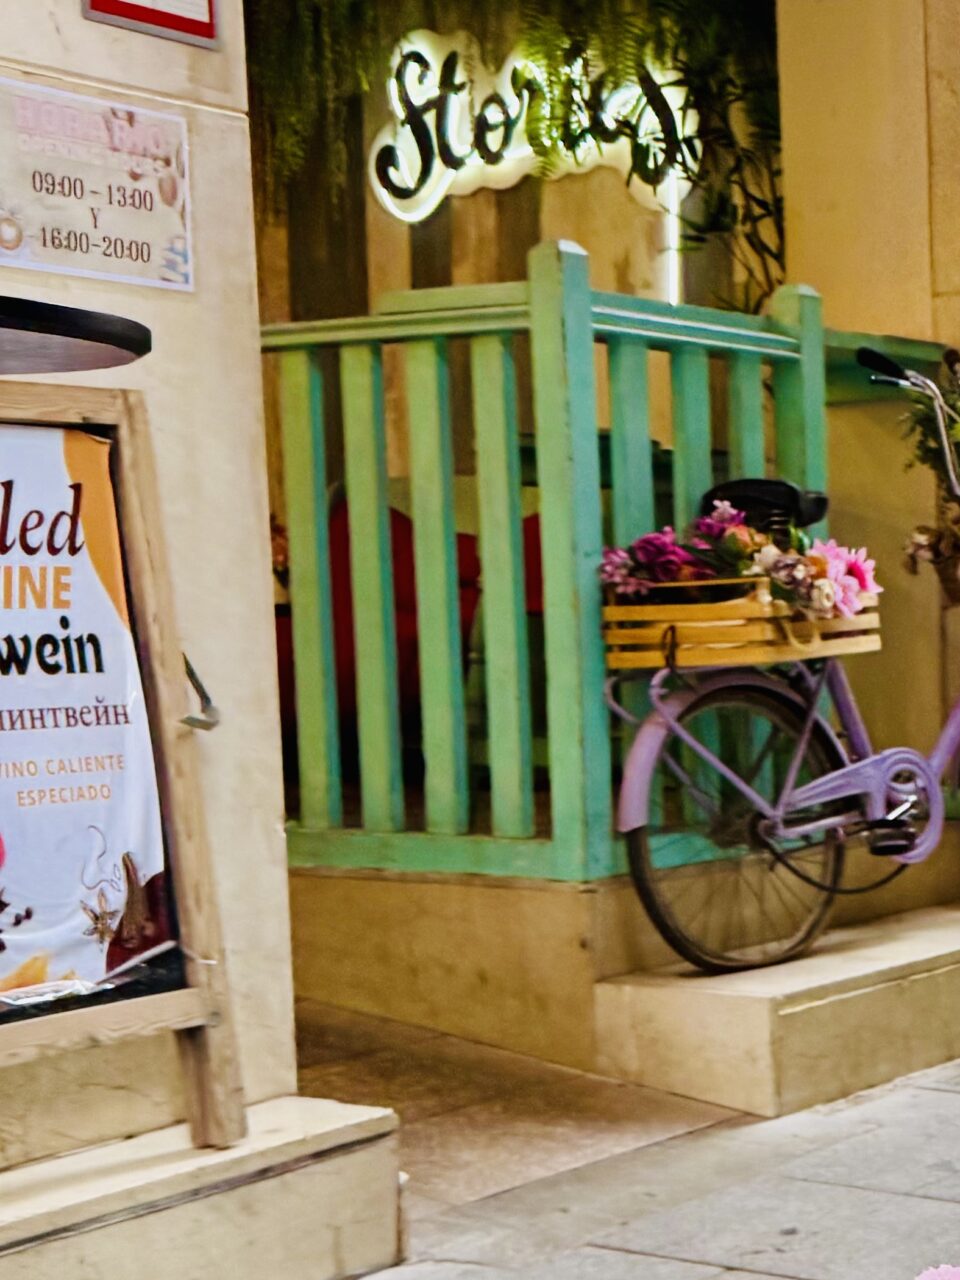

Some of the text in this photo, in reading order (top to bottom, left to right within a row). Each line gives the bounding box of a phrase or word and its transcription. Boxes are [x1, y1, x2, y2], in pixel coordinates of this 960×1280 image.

[32, 170, 84, 200] 09:00
[107, 184, 154, 212] 13:00
[90, 207, 101, 229] Y
[0, 565, 72, 610] INE
[0, 754, 126, 779] INO CALIENTE
[16, 783, 112, 808] ESPECIADO
